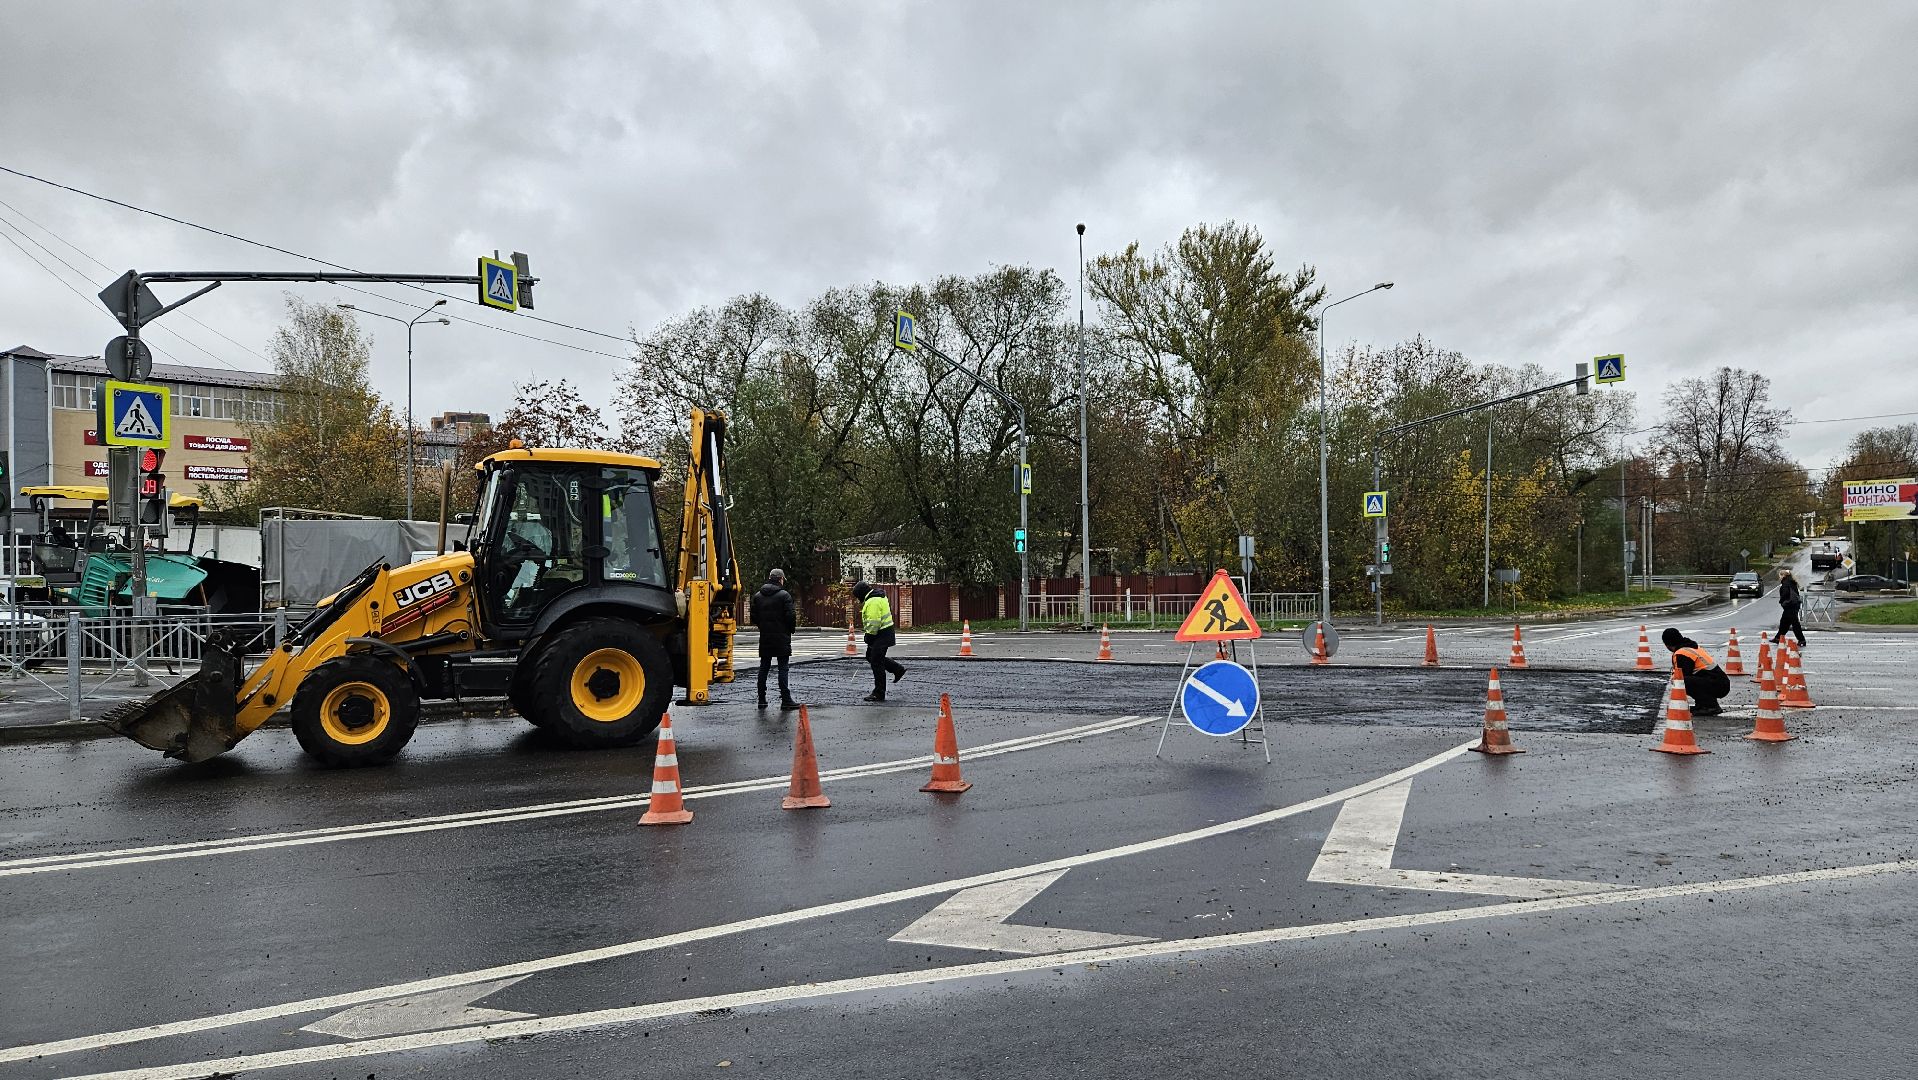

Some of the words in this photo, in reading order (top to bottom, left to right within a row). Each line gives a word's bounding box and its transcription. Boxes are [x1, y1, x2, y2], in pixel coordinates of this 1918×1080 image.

[94, 468, 109, 476] ДЛЯ
[188, 472, 229, 480] ПОСТЕЛЬНОЕ
[570, 481, 579, 500] JCB
[1848, 485, 1897, 495] ШИНО
[1848, 494, 1897, 504] МОНТАЖ
[398, 573, 454, 606] JCB
